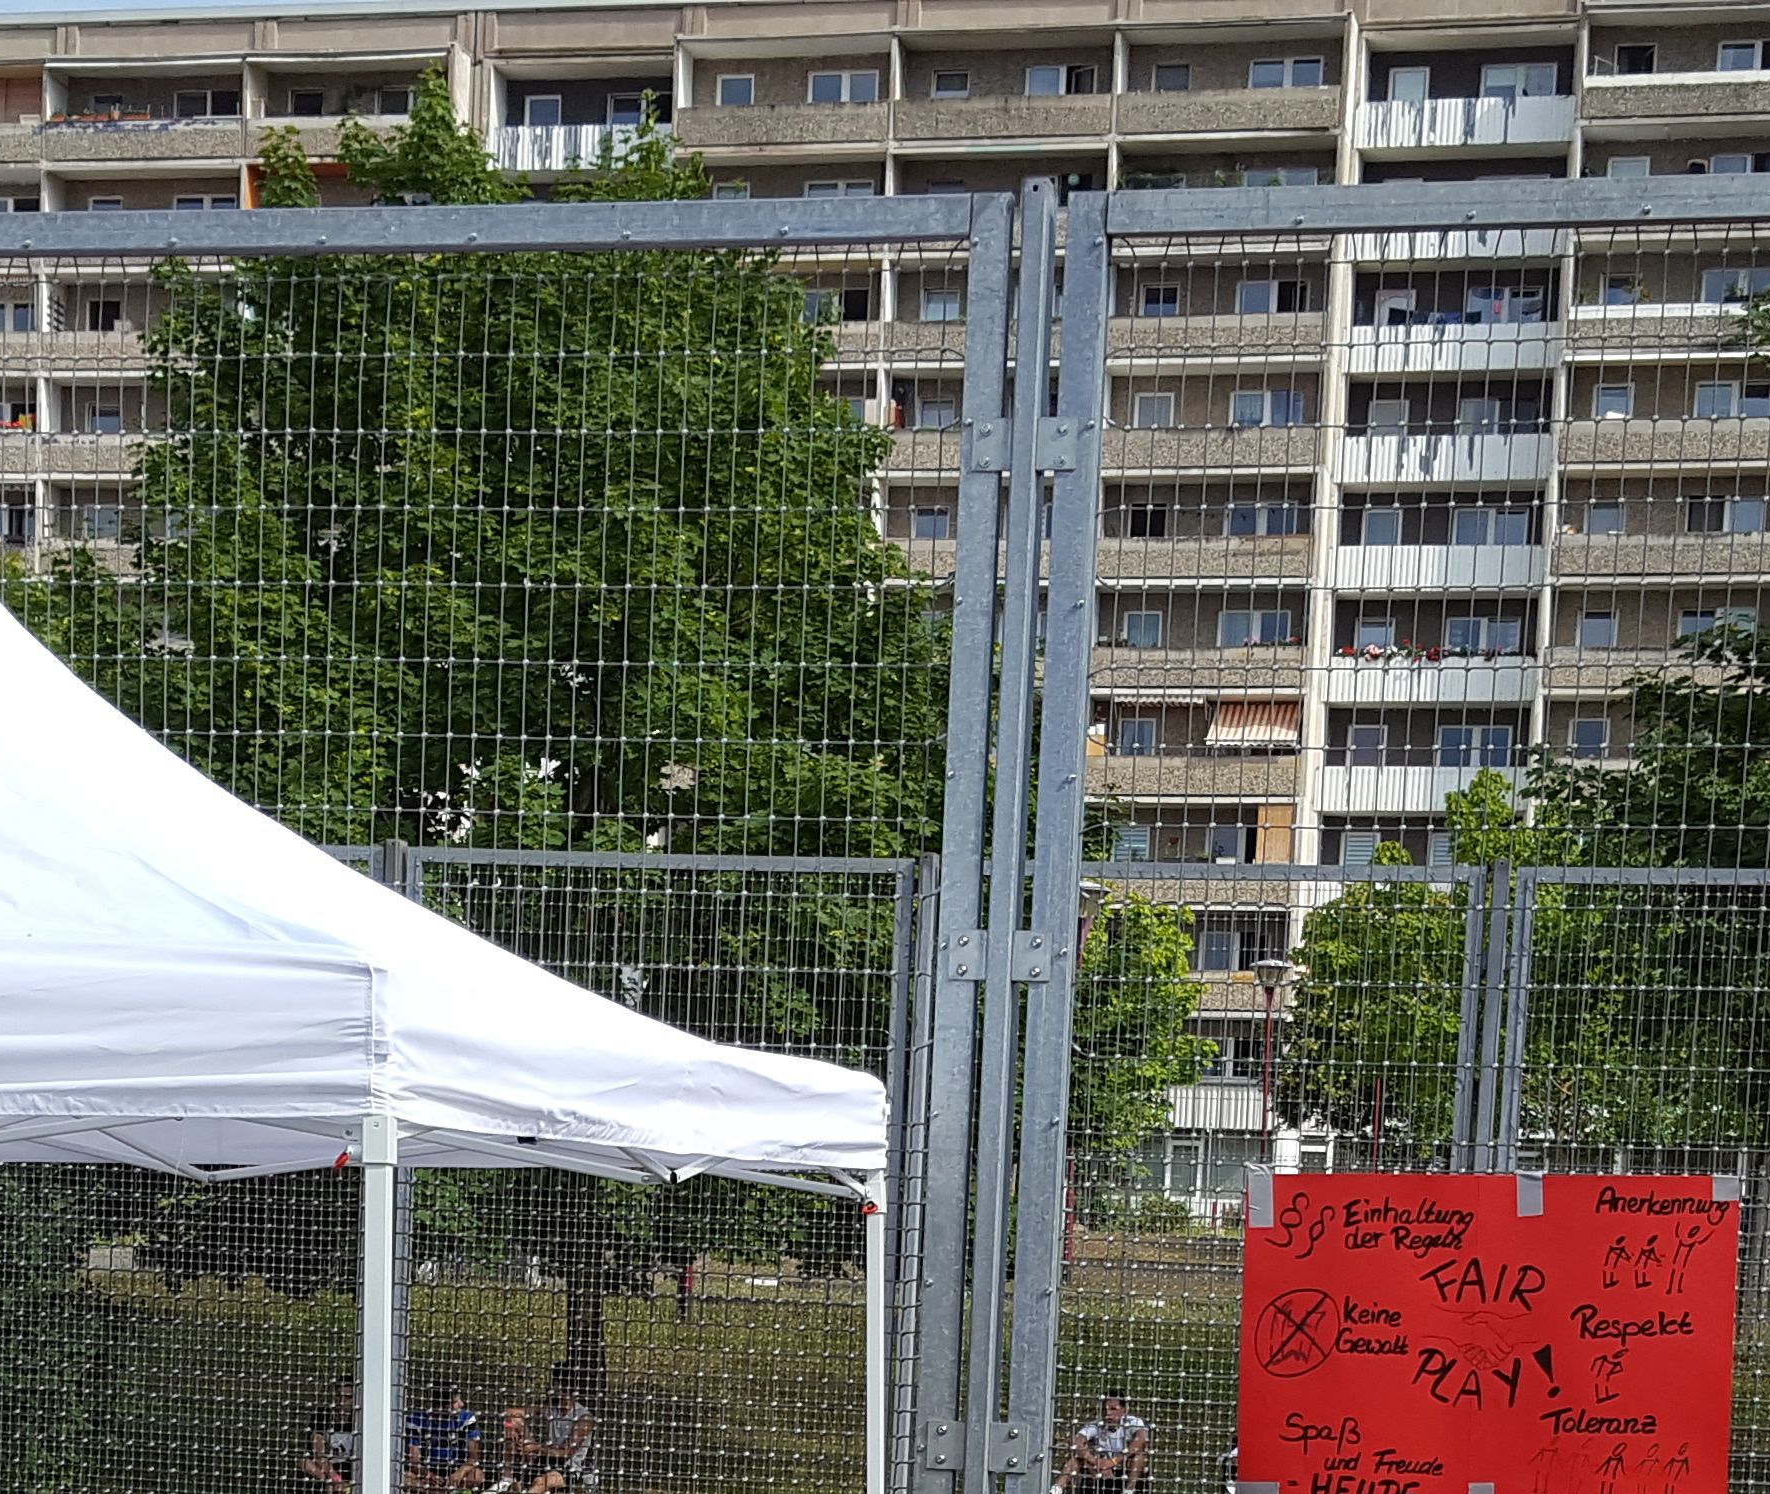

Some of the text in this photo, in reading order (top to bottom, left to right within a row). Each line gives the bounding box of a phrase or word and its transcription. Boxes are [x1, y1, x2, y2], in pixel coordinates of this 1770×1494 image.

[1342, 1196, 1474, 1237] Einhaltung
[1594, 1185, 1730, 1226] Anerkennung
[1344, 1225, 1463, 1260] der Regeln
[1419, 1257, 1546, 1312] FAIR
[1569, 1303, 1695, 1347] Respekt
[1279, 1412, 1361, 1455] Spaß
[1539, 1407, 1658, 1436] Toleranz
[1323, 1448, 1445, 1476] und Freude
